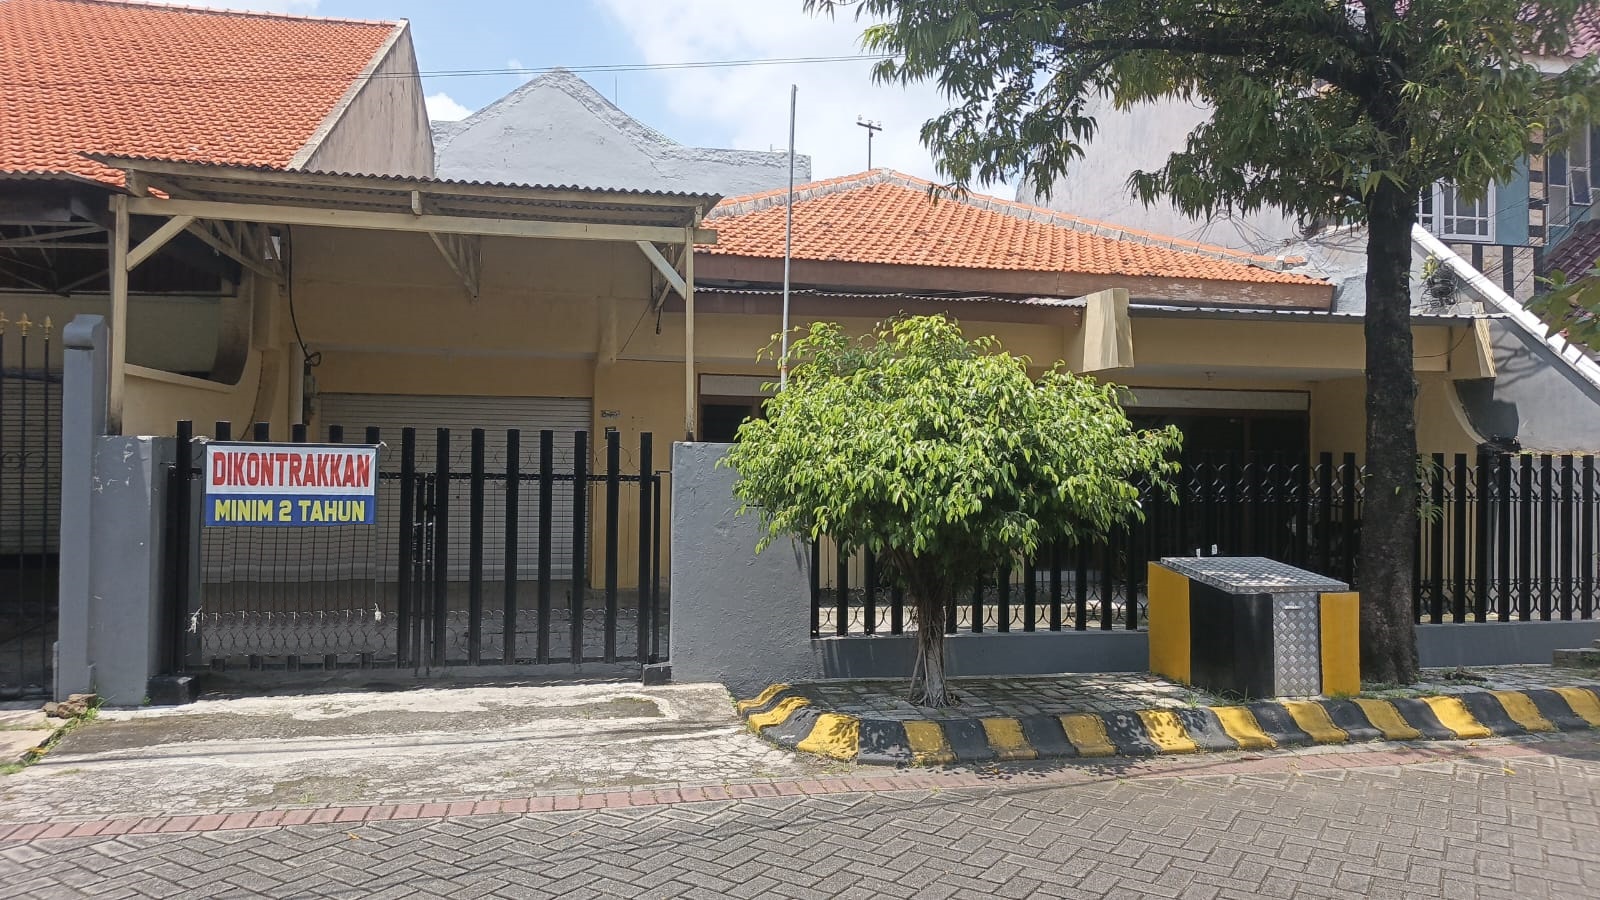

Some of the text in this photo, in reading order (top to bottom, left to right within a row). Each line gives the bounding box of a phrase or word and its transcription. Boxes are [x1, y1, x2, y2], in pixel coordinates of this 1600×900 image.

[212, 452, 370, 488] DIKONTRAKKAN
[214, 499, 365, 522] MINIM 2 TAHUN
